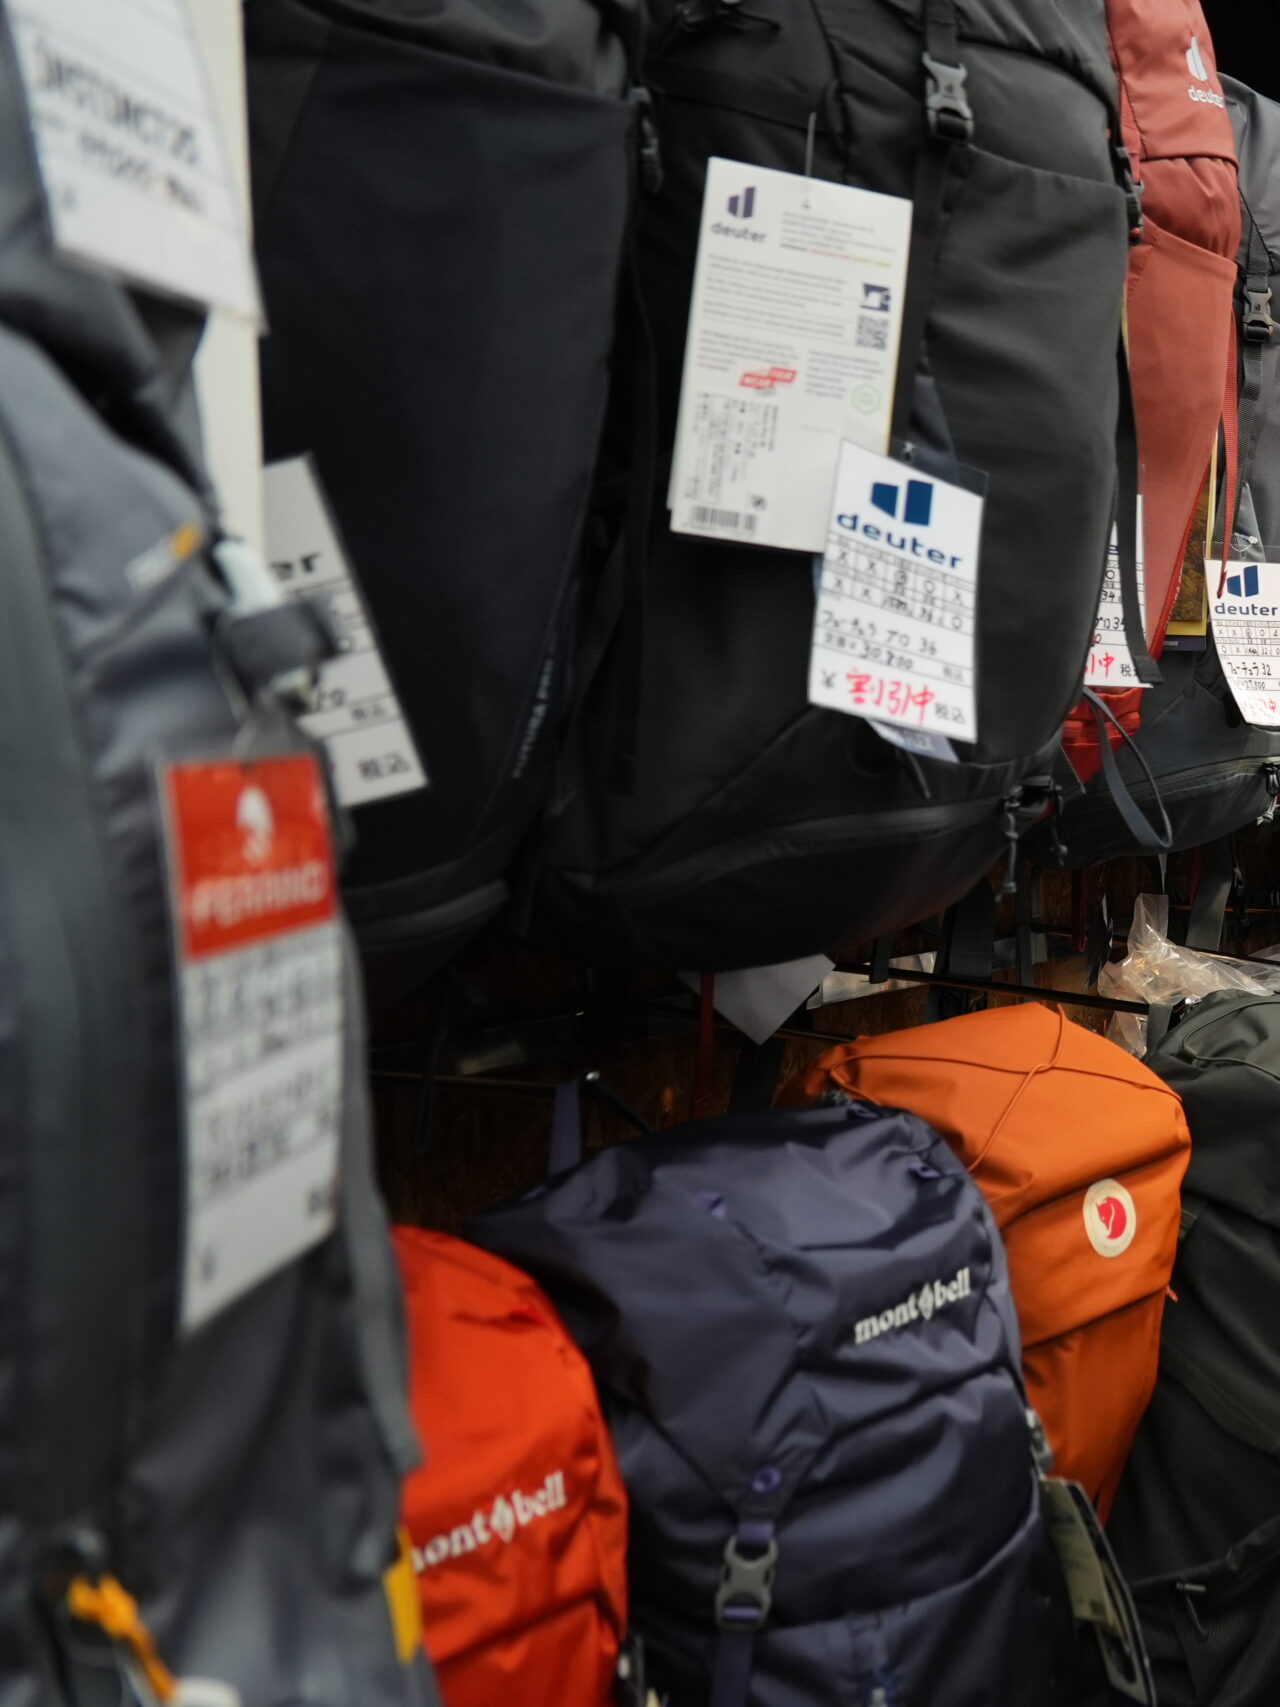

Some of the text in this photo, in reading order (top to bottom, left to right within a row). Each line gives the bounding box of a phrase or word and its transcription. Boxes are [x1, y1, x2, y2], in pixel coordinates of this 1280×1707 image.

[711, 221, 768, 244] deuter
[836, 512, 964, 570] deuter
[1214, 602, 1279, 616] deuter
[1262, 663, 1272, 676] 32
